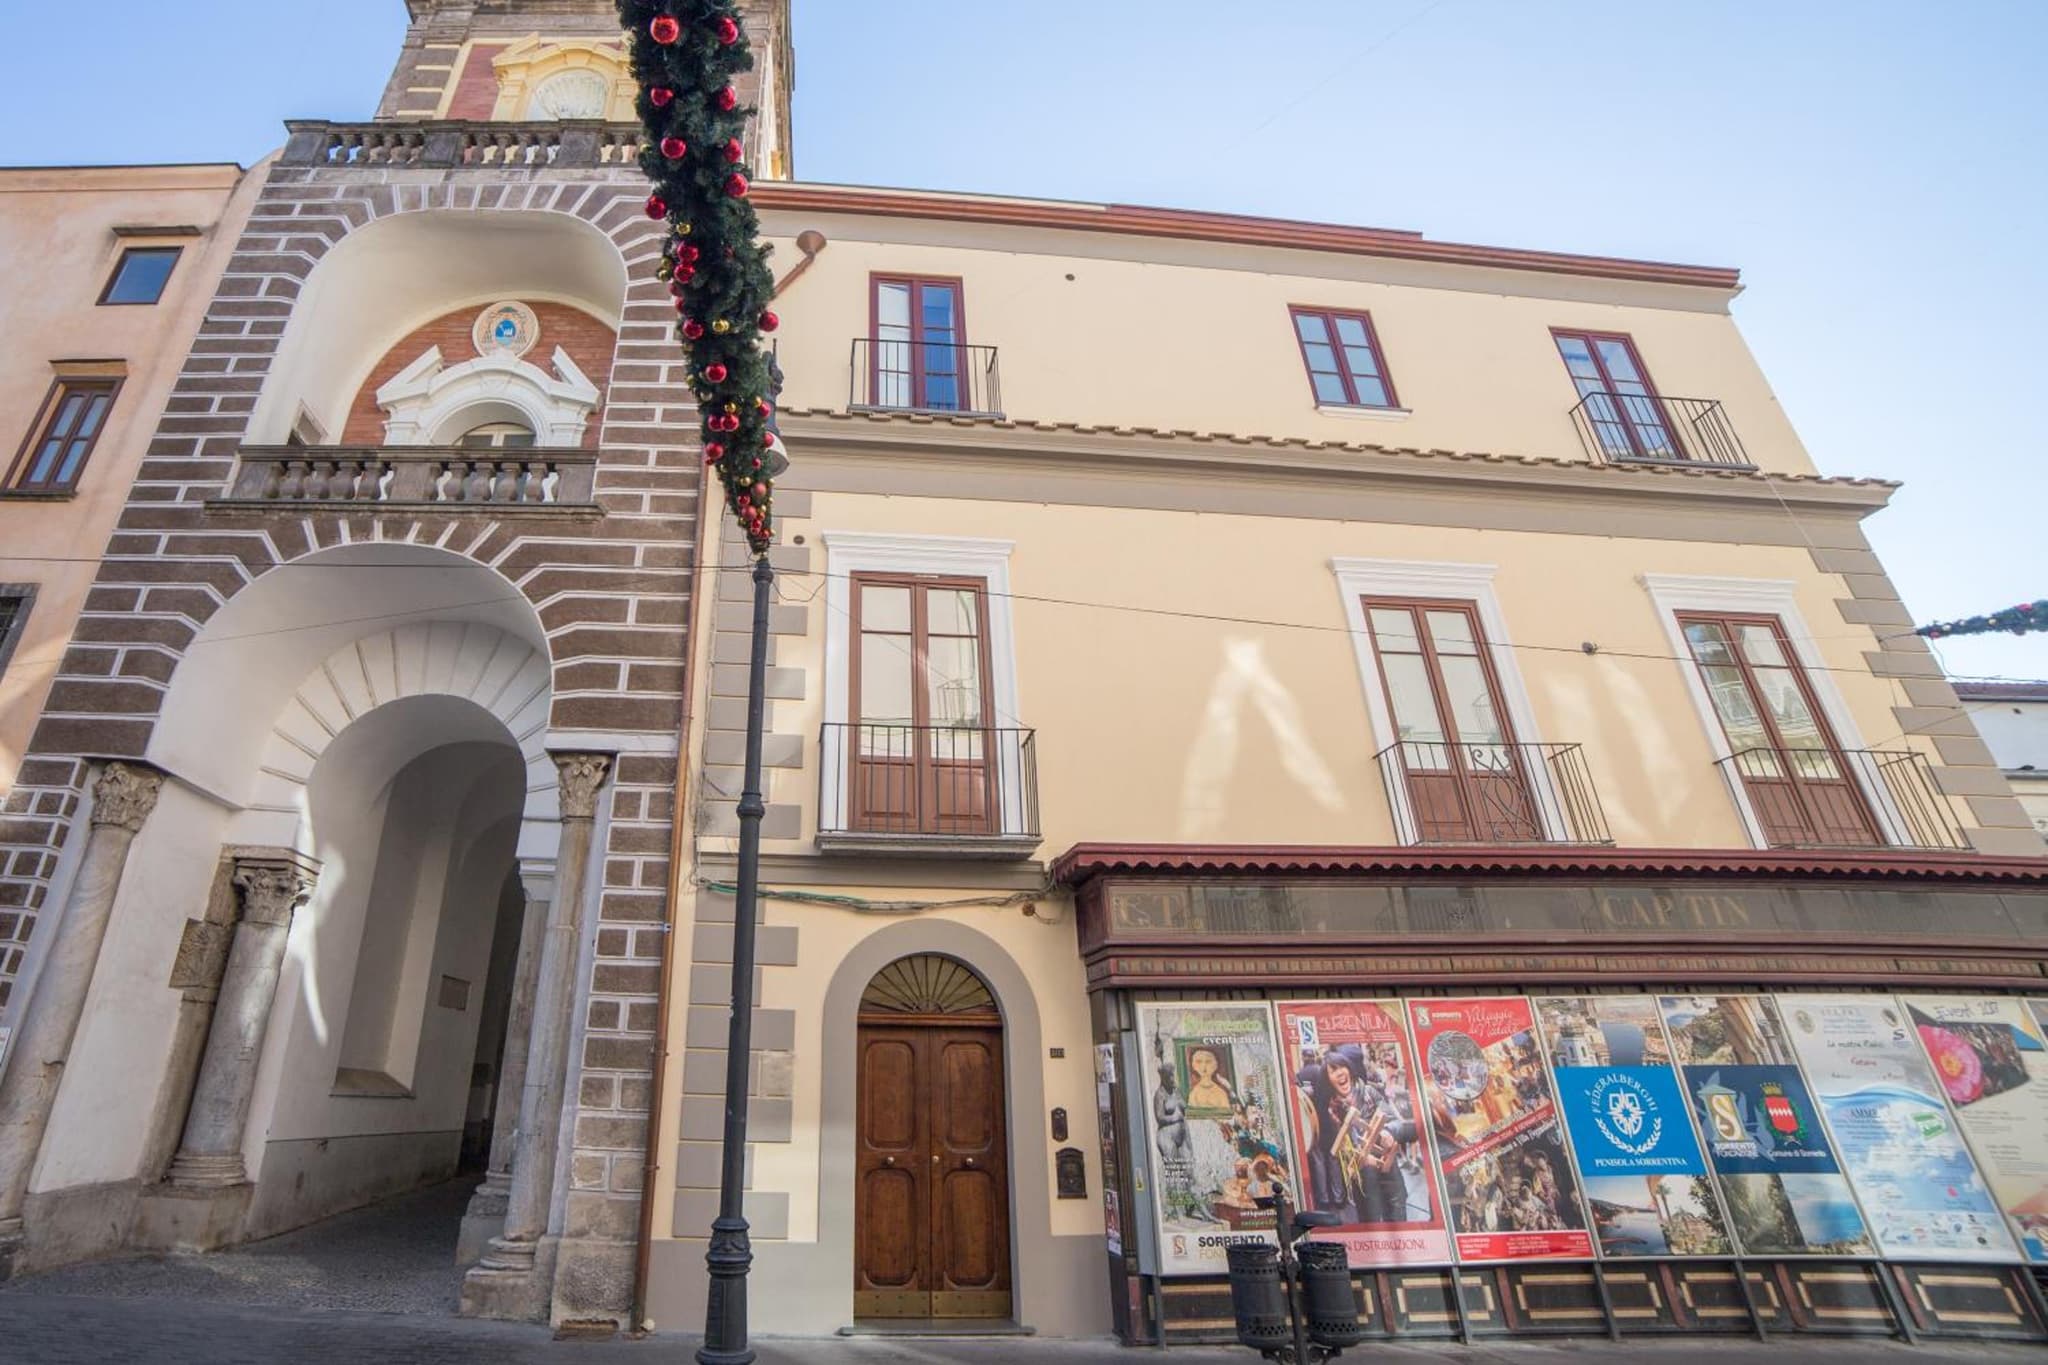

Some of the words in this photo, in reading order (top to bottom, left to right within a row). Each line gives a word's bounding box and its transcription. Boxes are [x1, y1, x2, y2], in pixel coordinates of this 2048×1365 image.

[1595, 1157, 1635, 1168] PENISOLA
[1635, 1156, 1688, 1167] SORRENTINA
[1198, 1235, 1265, 1248] SORRENTO
